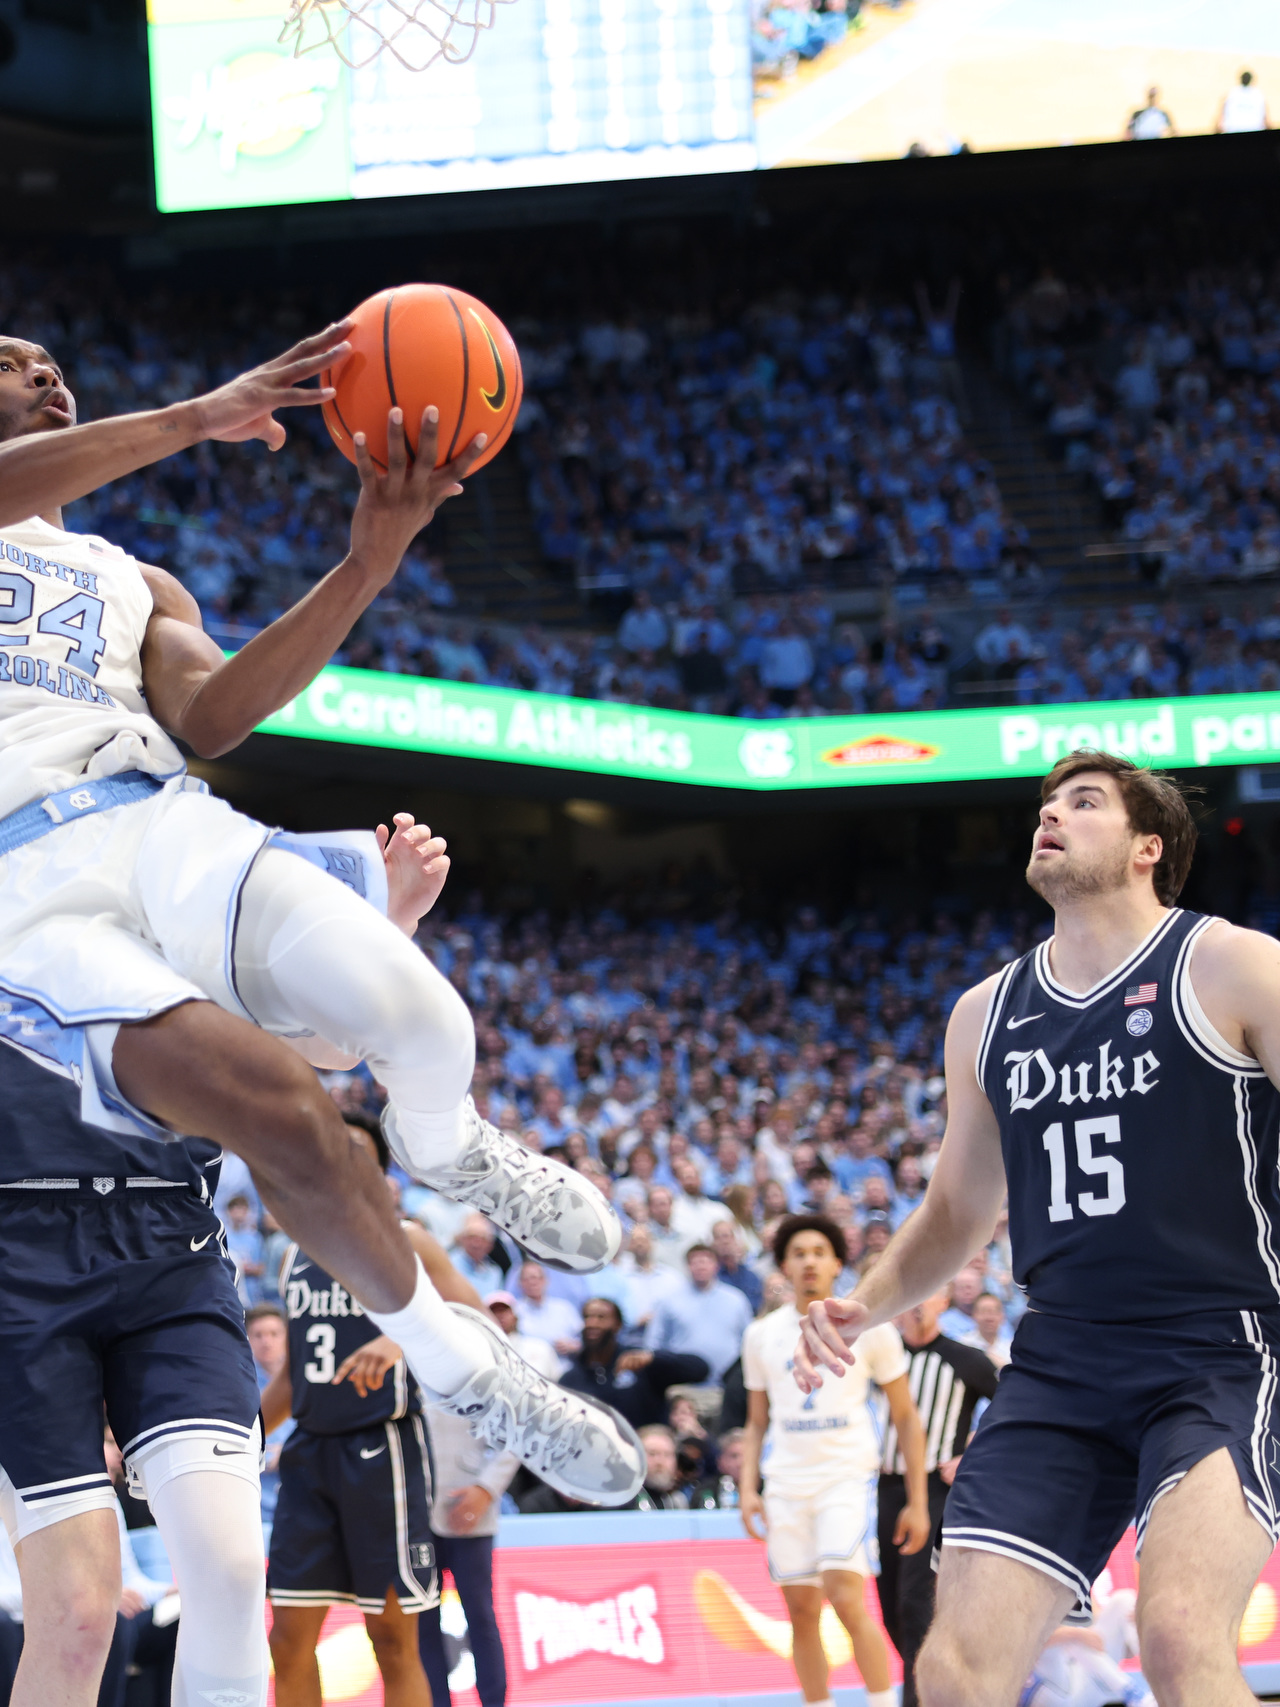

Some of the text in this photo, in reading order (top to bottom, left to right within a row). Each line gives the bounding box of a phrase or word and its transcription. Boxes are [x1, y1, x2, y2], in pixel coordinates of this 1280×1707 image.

[307, 675, 693, 770] Carolina Athletics
[998, 704, 1177, 765] Proud
[1003, 1039, 1161, 1115] Duke
[1042, 1114, 1127, 1223] 15
[305, 1323, 336, 1384] 3
